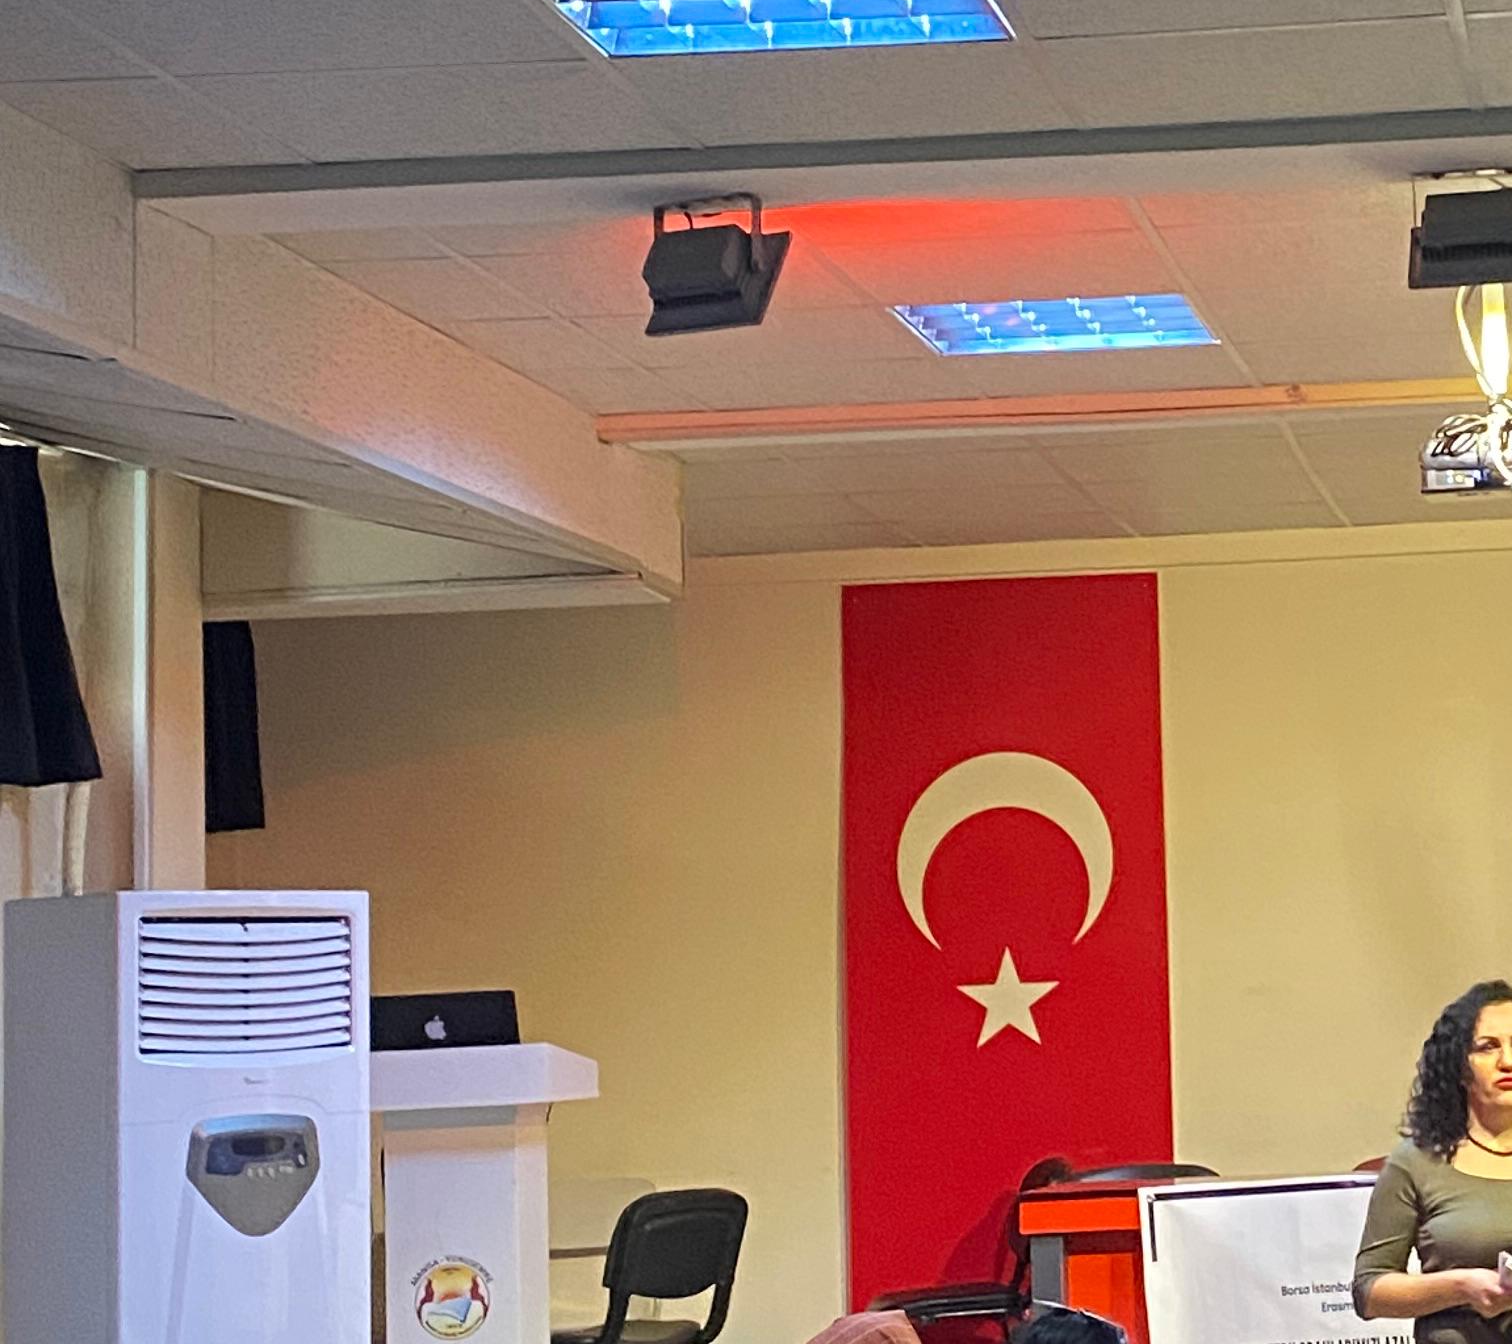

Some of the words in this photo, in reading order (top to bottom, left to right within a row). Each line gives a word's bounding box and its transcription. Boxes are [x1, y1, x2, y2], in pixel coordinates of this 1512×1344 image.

[1281, 1286, 1310, 1297] Borsa
[1312, 1281, 1352, 1294] İstanbu
[1321, 1301, 1354, 1313] Erasm
